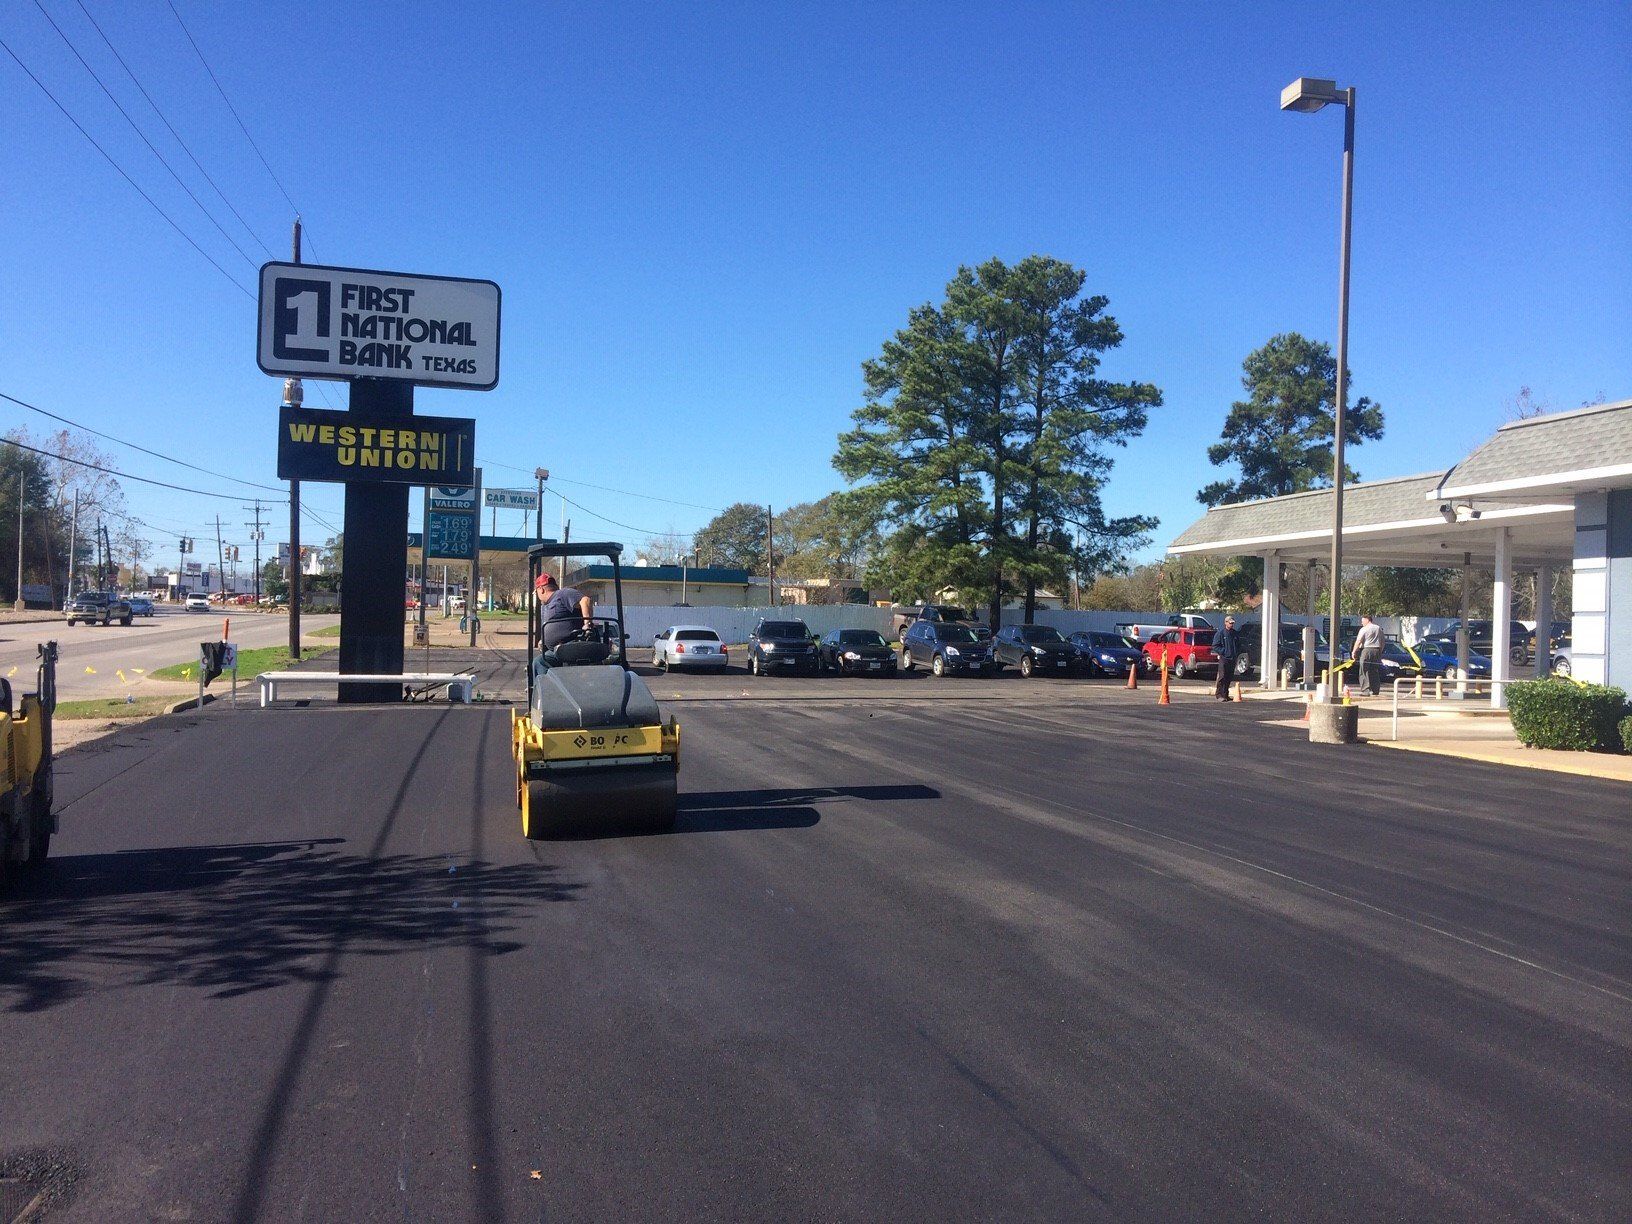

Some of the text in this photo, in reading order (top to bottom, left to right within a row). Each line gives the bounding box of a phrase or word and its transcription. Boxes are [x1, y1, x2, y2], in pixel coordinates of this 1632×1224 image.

[341, 283, 415, 314] FIRST
[341, 313, 477, 347] NATIONAL
[339, 340, 477, 374] BANK TEXAS
[289, 423, 440, 450] WESTERN
[337, 447, 439, 471] UNION
[435, 500, 470, 508] VALERO
[486, 493, 536, 505] CAR WASH
